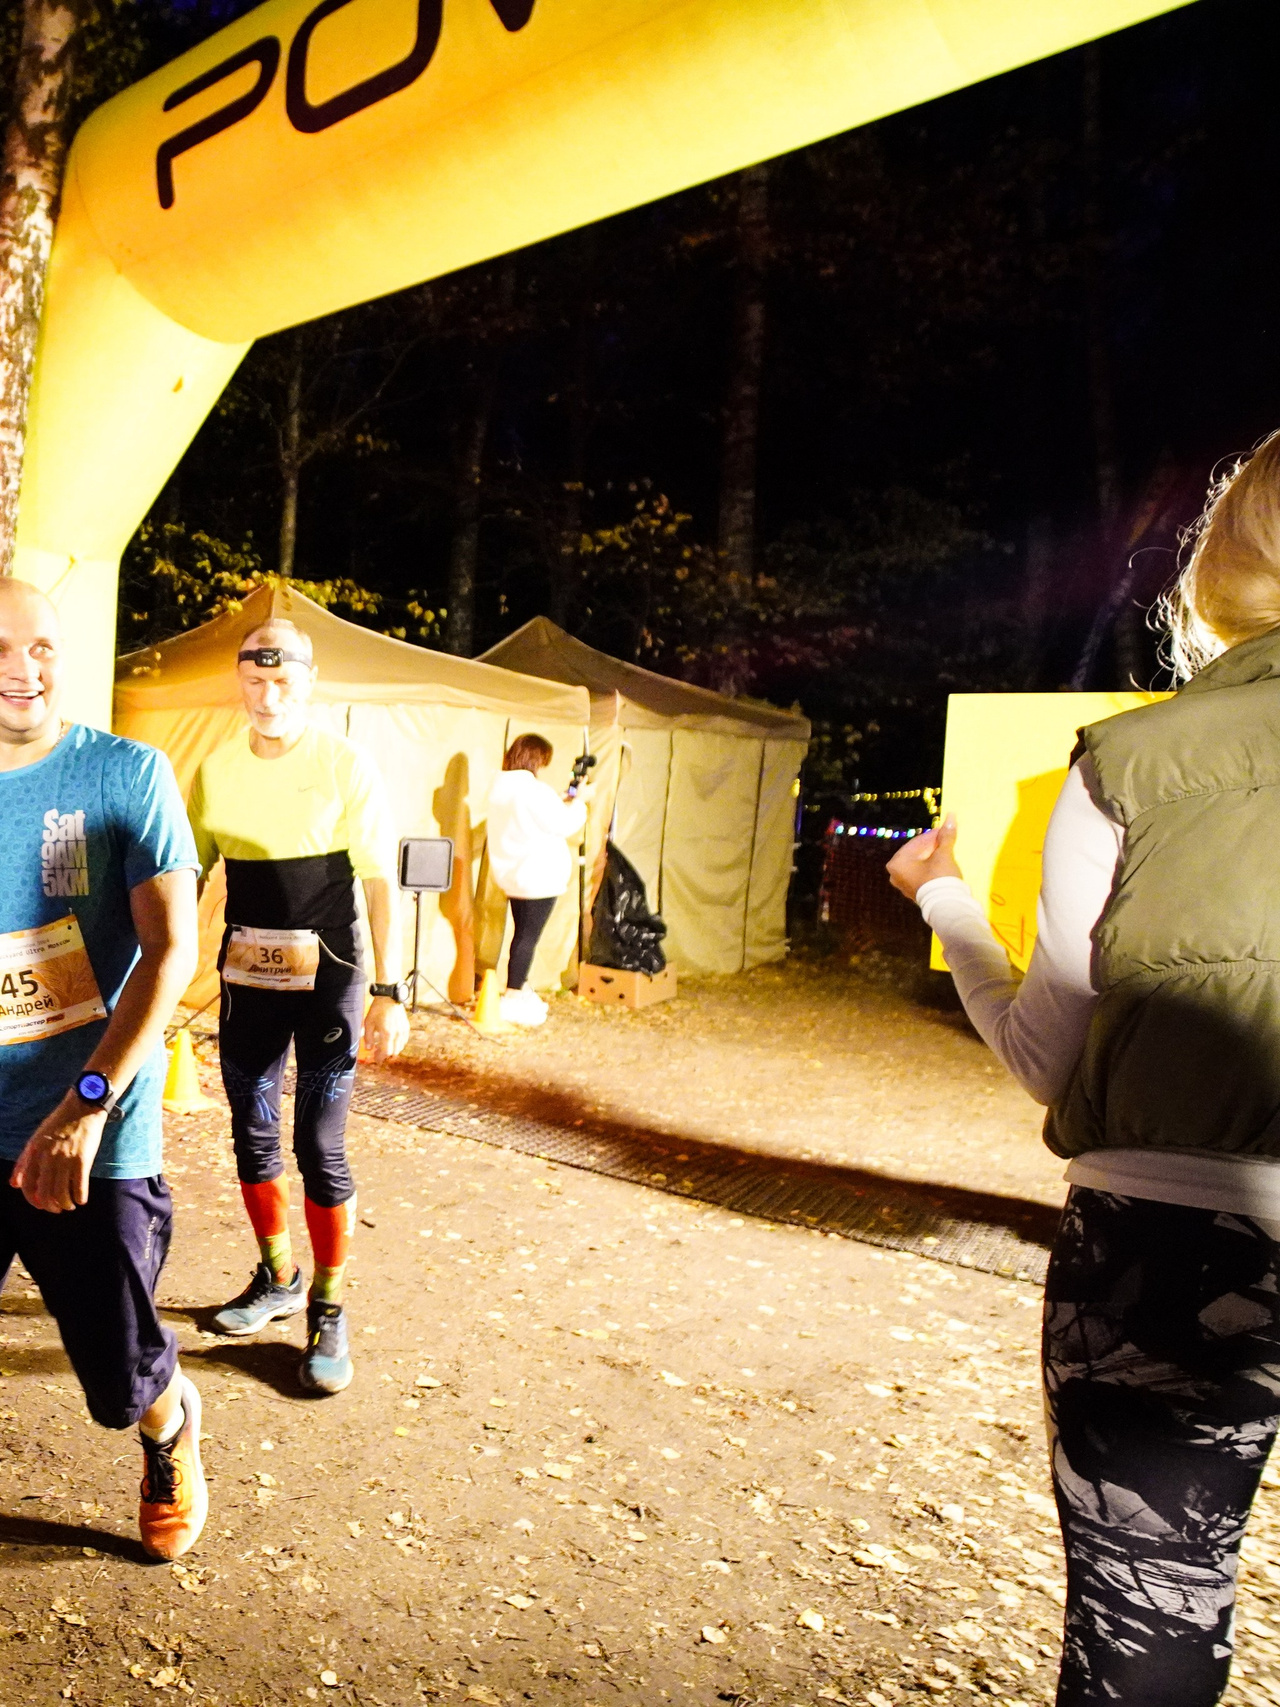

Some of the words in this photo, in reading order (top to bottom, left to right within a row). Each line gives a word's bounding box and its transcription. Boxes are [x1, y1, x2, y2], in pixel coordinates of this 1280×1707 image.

[156, 0, 536, 209] PO
[42, 808, 86, 842] Sat
[41, 841, 87, 869] 9AM
[42, 869, 89, 896] 5KM
[260, 947, 284, 964] 36
[1, 969, 39, 998] 45
